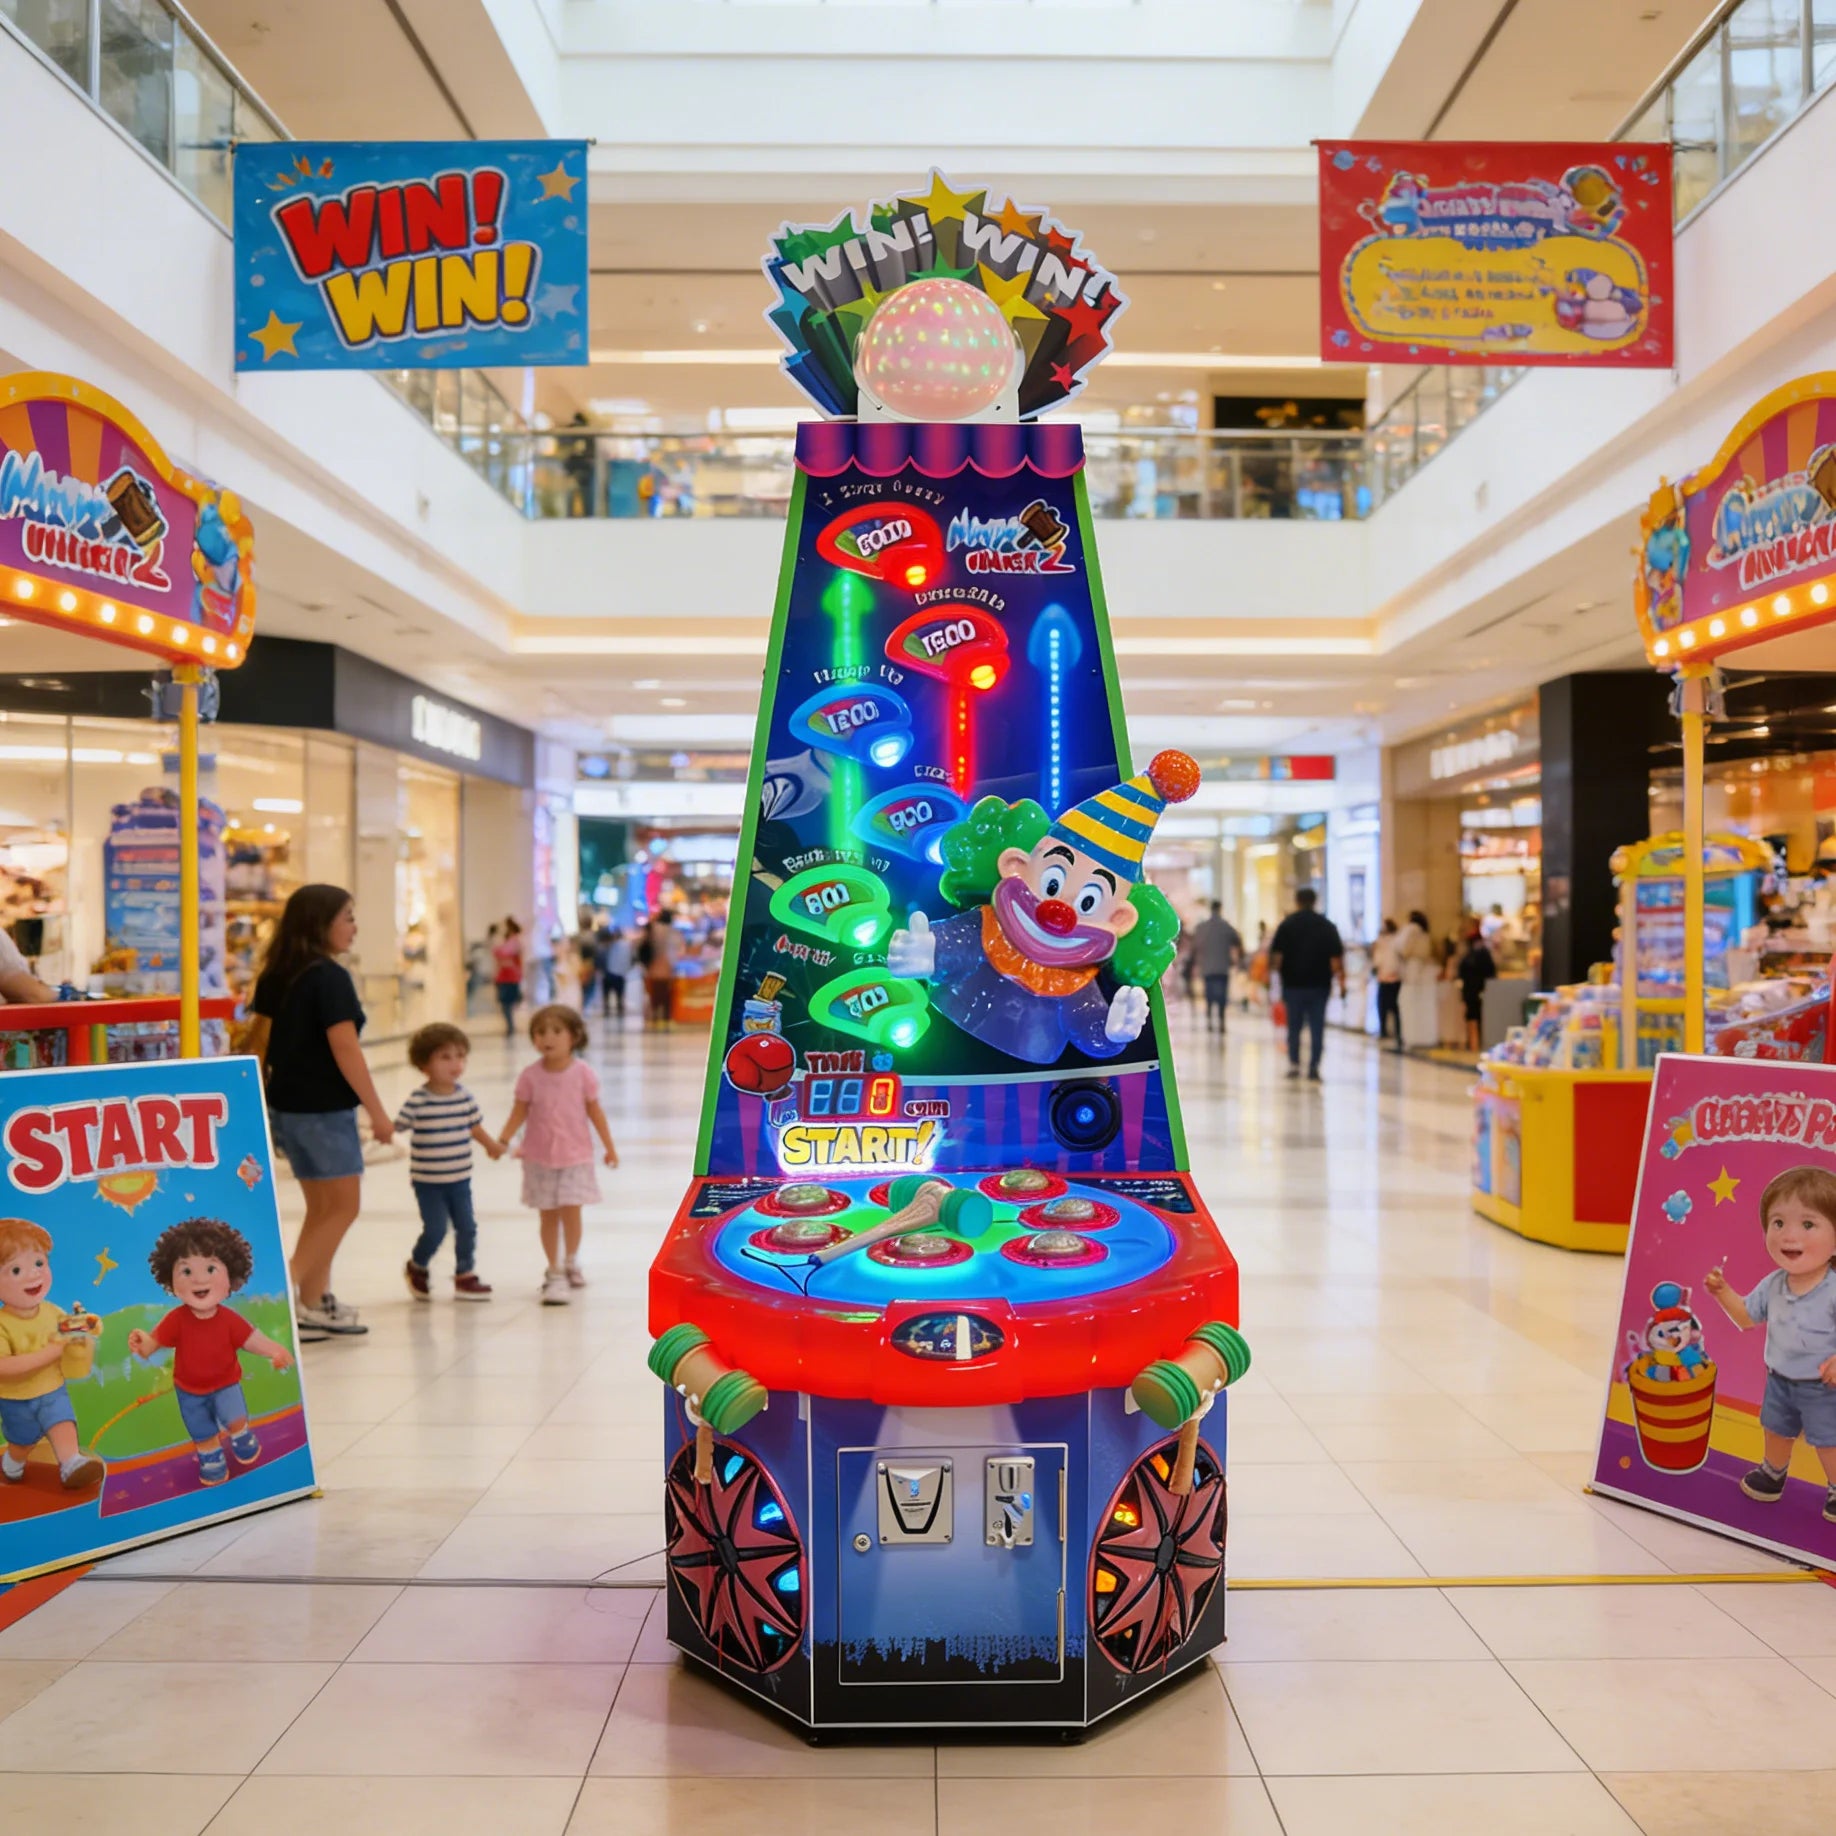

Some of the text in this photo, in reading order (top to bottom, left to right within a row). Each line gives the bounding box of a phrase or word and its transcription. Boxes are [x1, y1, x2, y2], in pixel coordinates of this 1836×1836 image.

[278, 170, 503, 279] WIN!
[782, 211, 1112, 306] WIN! WIN!
[324, 243, 537, 346] WIN!
[7, 1096, 224, 1190] START
[783, 1119, 936, 1166] START!
